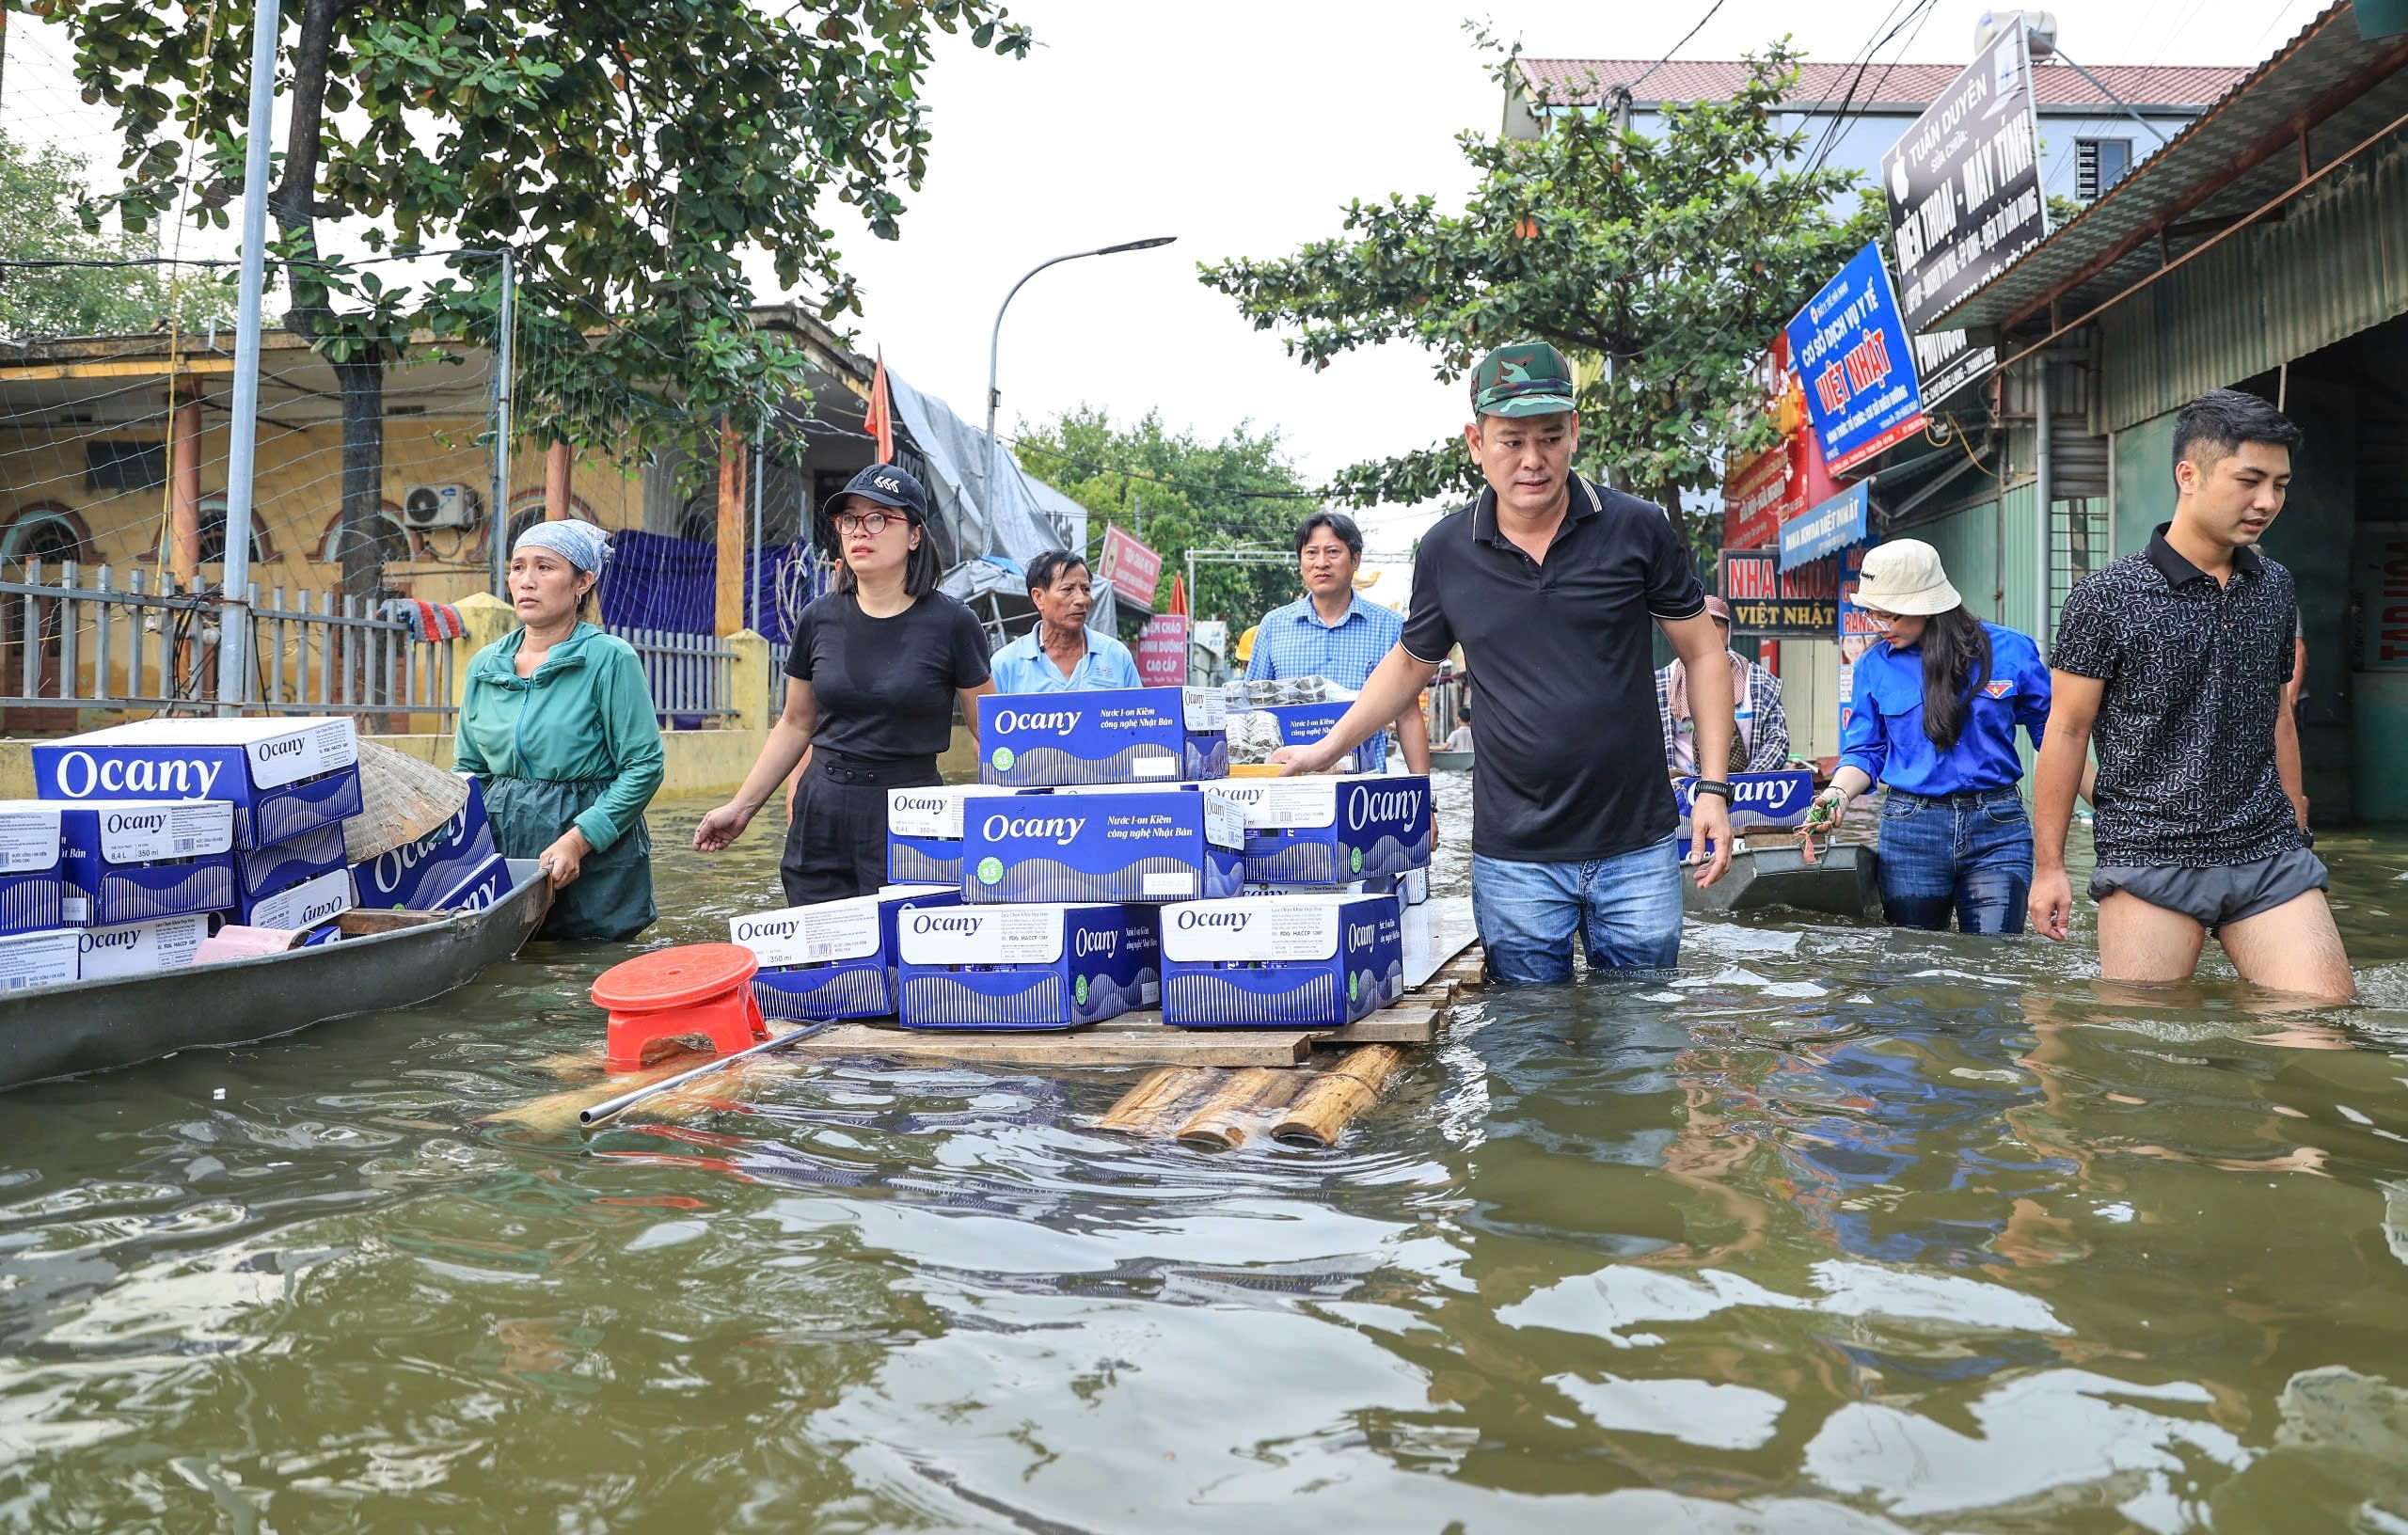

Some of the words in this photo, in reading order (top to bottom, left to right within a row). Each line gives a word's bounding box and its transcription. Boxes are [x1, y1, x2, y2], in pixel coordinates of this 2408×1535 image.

[1909, 120, 1941, 166] TUẤN
[1941, 73, 1987, 135] DUYÊN
[1895, 209, 1924, 277] ĐIỆN
[1920, 176, 1956, 251] THOẠI
[1962, 135, 1994, 214] MÁY
[1993, 109, 2033, 186] TÍNH
[1802, 340, 1815, 367] CƠ
[1814, 328, 1827, 356] SỞ
[1824, 315, 1847, 349] DỊCH
[1844, 304, 1861, 330] VỤ
[1857, 296, 1866, 318] Y
[1863, 277, 1878, 311] TẾ
[1814, 360, 1851, 415] VIỆT
[1844, 328, 1892, 395] NHẬT
[1728, 559, 1776, 599] NHA
[1782, 560, 1838, 600] KHOA
[1735, 601, 1780, 628] VIỆT
[1783, 601, 1836, 628] NHẬT
[1146, 659, 1162, 672] CAO
[1163, 656, 1177, 673] CẤP
[1185, 690, 1204, 709] Ocany
[994, 710, 1082, 736] Ocany
[1100, 709, 1119, 718] Nước
[1136, 707, 1155, 716] Kiềm
[1101, 719, 1117, 729] công
[1119, 720, 1137, 729] nghệ
[1138, 719, 1156, 728] Nhật
[259, 737, 306, 762] Ocany
[57, 752, 223, 800] Ocany
[895, 796, 947, 815] Ocany
[1687, 780, 1798, 809] any
[1107, 815, 1130, 825] Nước
[1132, 815, 1148, 825] I-on
[1149, 815, 1171, 824] Kiềm
[1207, 799, 1225, 821] Ocany
[1348, 785, 1422, 832] Ocany
[107, 814, 166, 833] Ocany
[982, 815, 1085, 846] Ocany
[1107, 829, 1128, 839] công
[1130, 829, 1151, 839] nghệ
[1152, 828, 1174, 838] Nhật
[300, 896, 342, 924] Ocany
[1178, 910, 1252, 932] Ocany
[737, 921, 800, 941] Ocany
[913, 915, 983, 936] Ocany
[1349, 923, 1374, 953] Ocany
[79, 929, 141, 953] Ocany
[1075, 927, 1118, 958] Ocany
